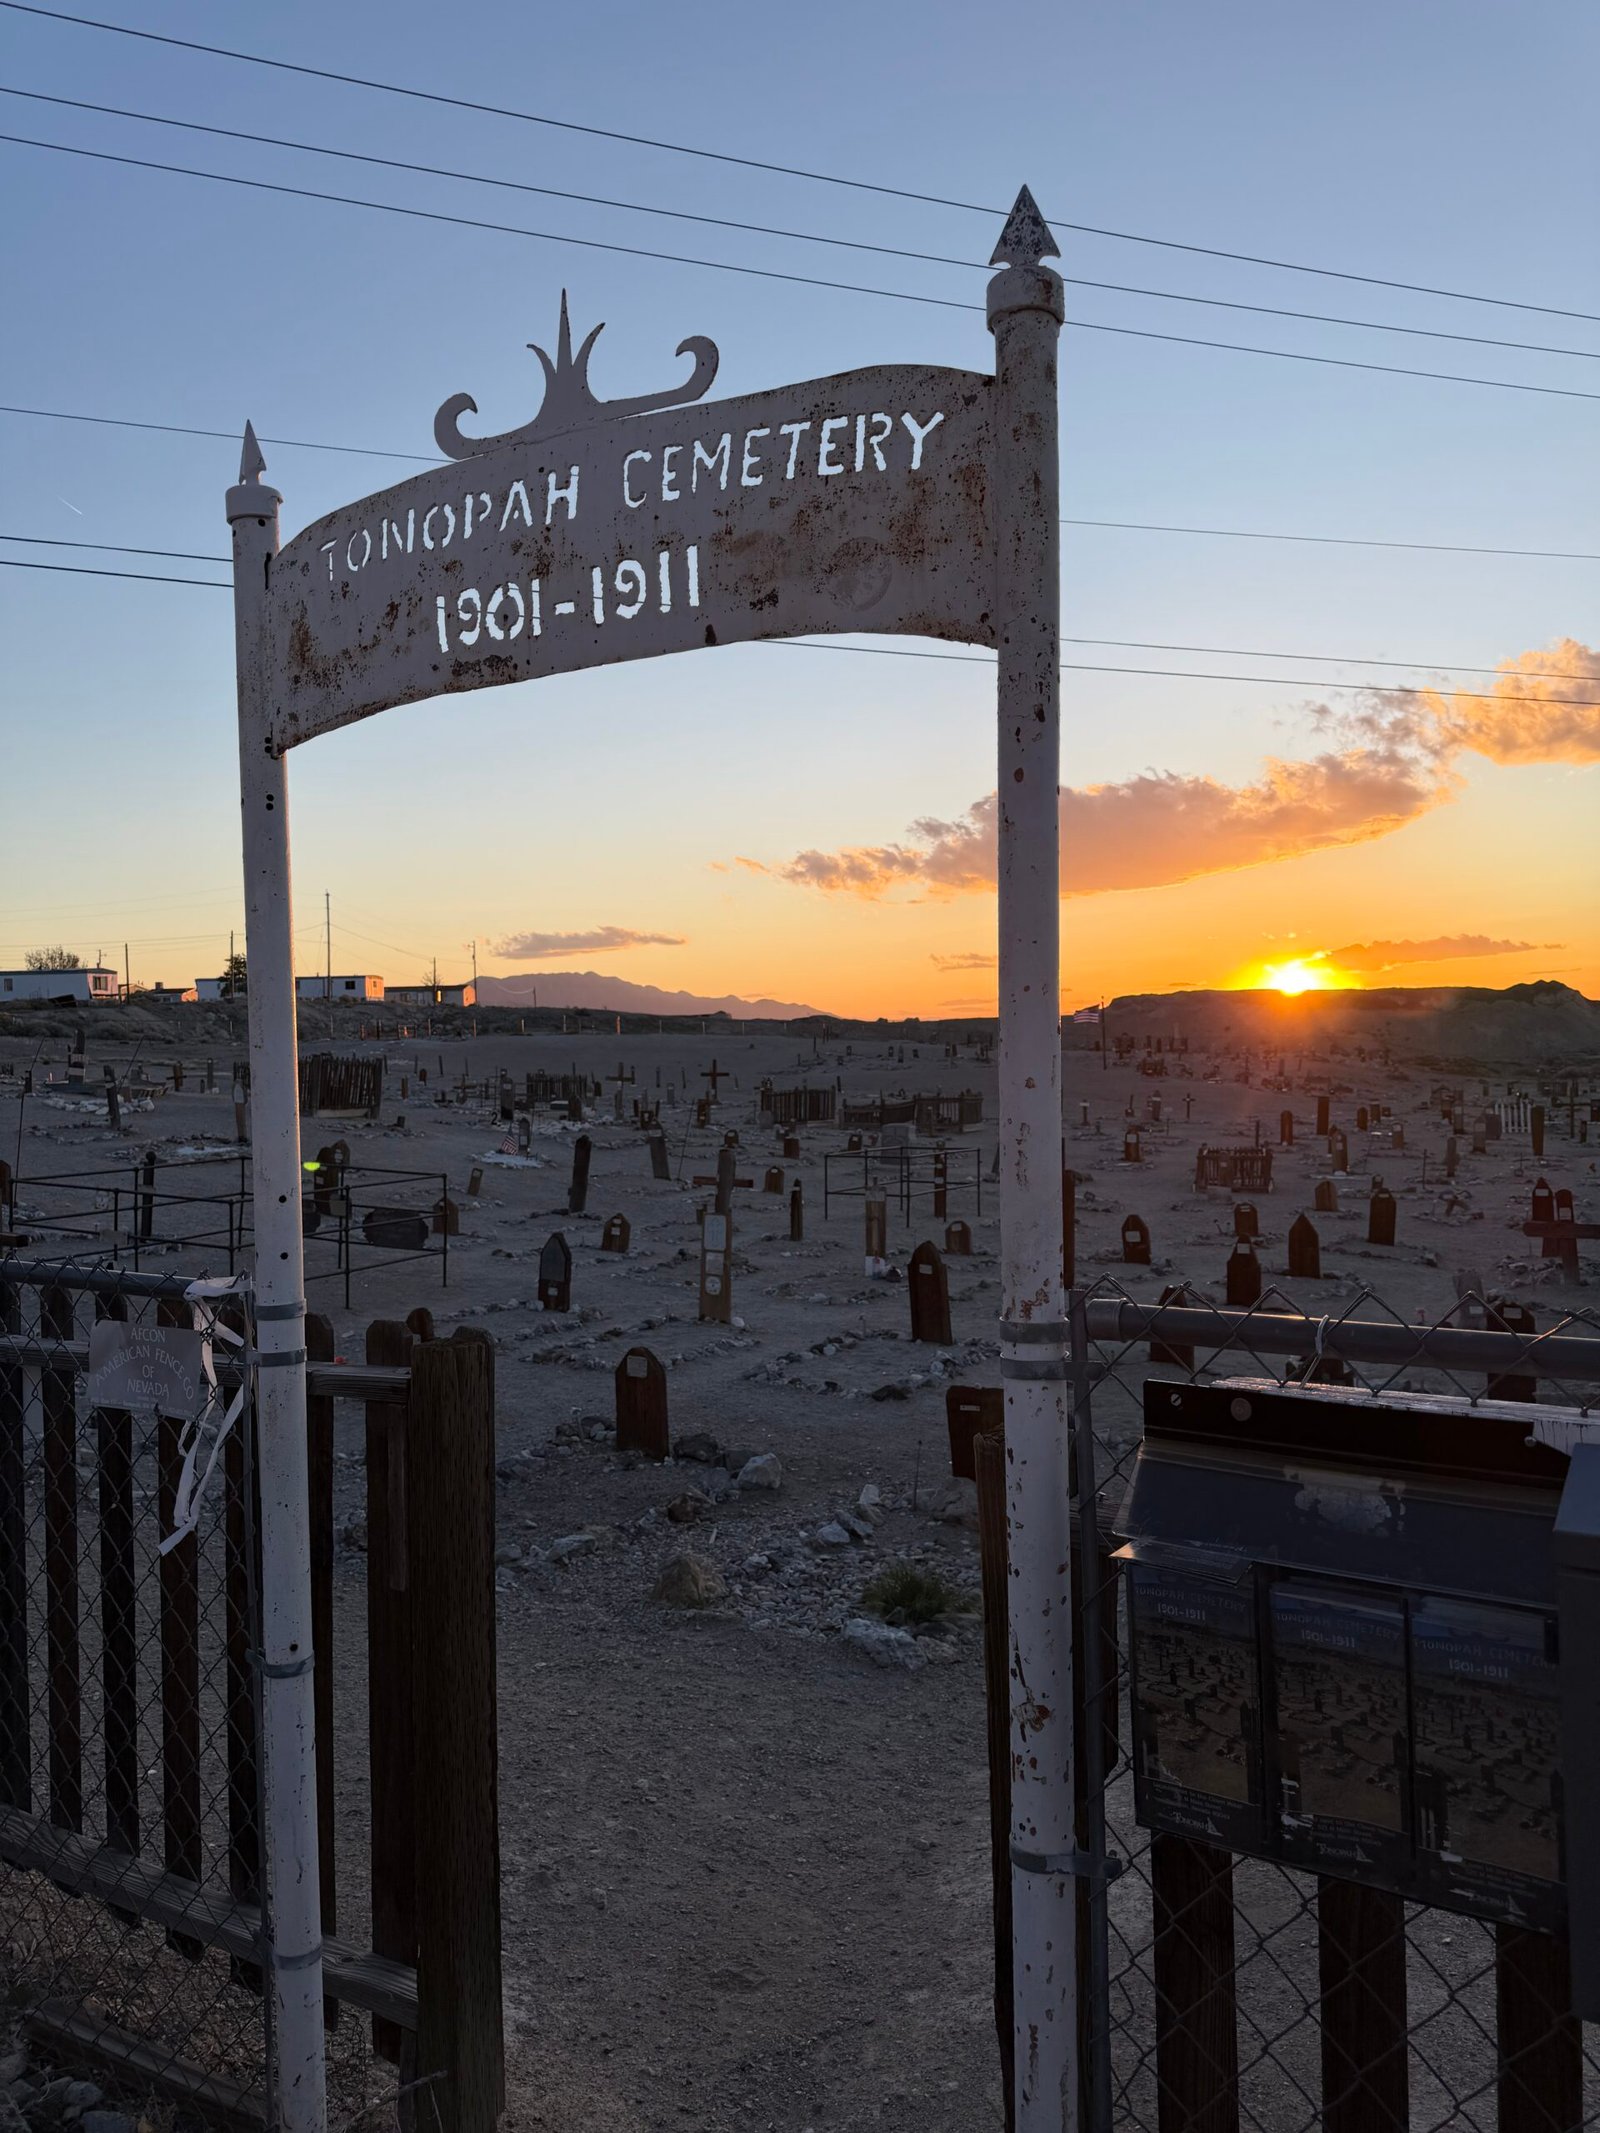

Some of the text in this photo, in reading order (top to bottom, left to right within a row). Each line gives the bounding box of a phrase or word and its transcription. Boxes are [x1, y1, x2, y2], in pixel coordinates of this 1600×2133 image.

[320, 411, 944, 581] TONOPAH CEMETERY
[435, 545, 699, 653] 1901-1911
[130, 1328, 166, 1343] AFCON
[96, 1345, 151, 1386] AMERICAN
[155, 1348, 185, 1379] FENCE
[142, 1365, 155, 1378] OF
[127, 1379, 169, 1399] NEVADA
[1157, 1603, 1206, 1620] 1901-1911
[1301, 1629, 1355, 1648] 1901-1911
[1448, 1658, 1508, 1678] 1901-1911
